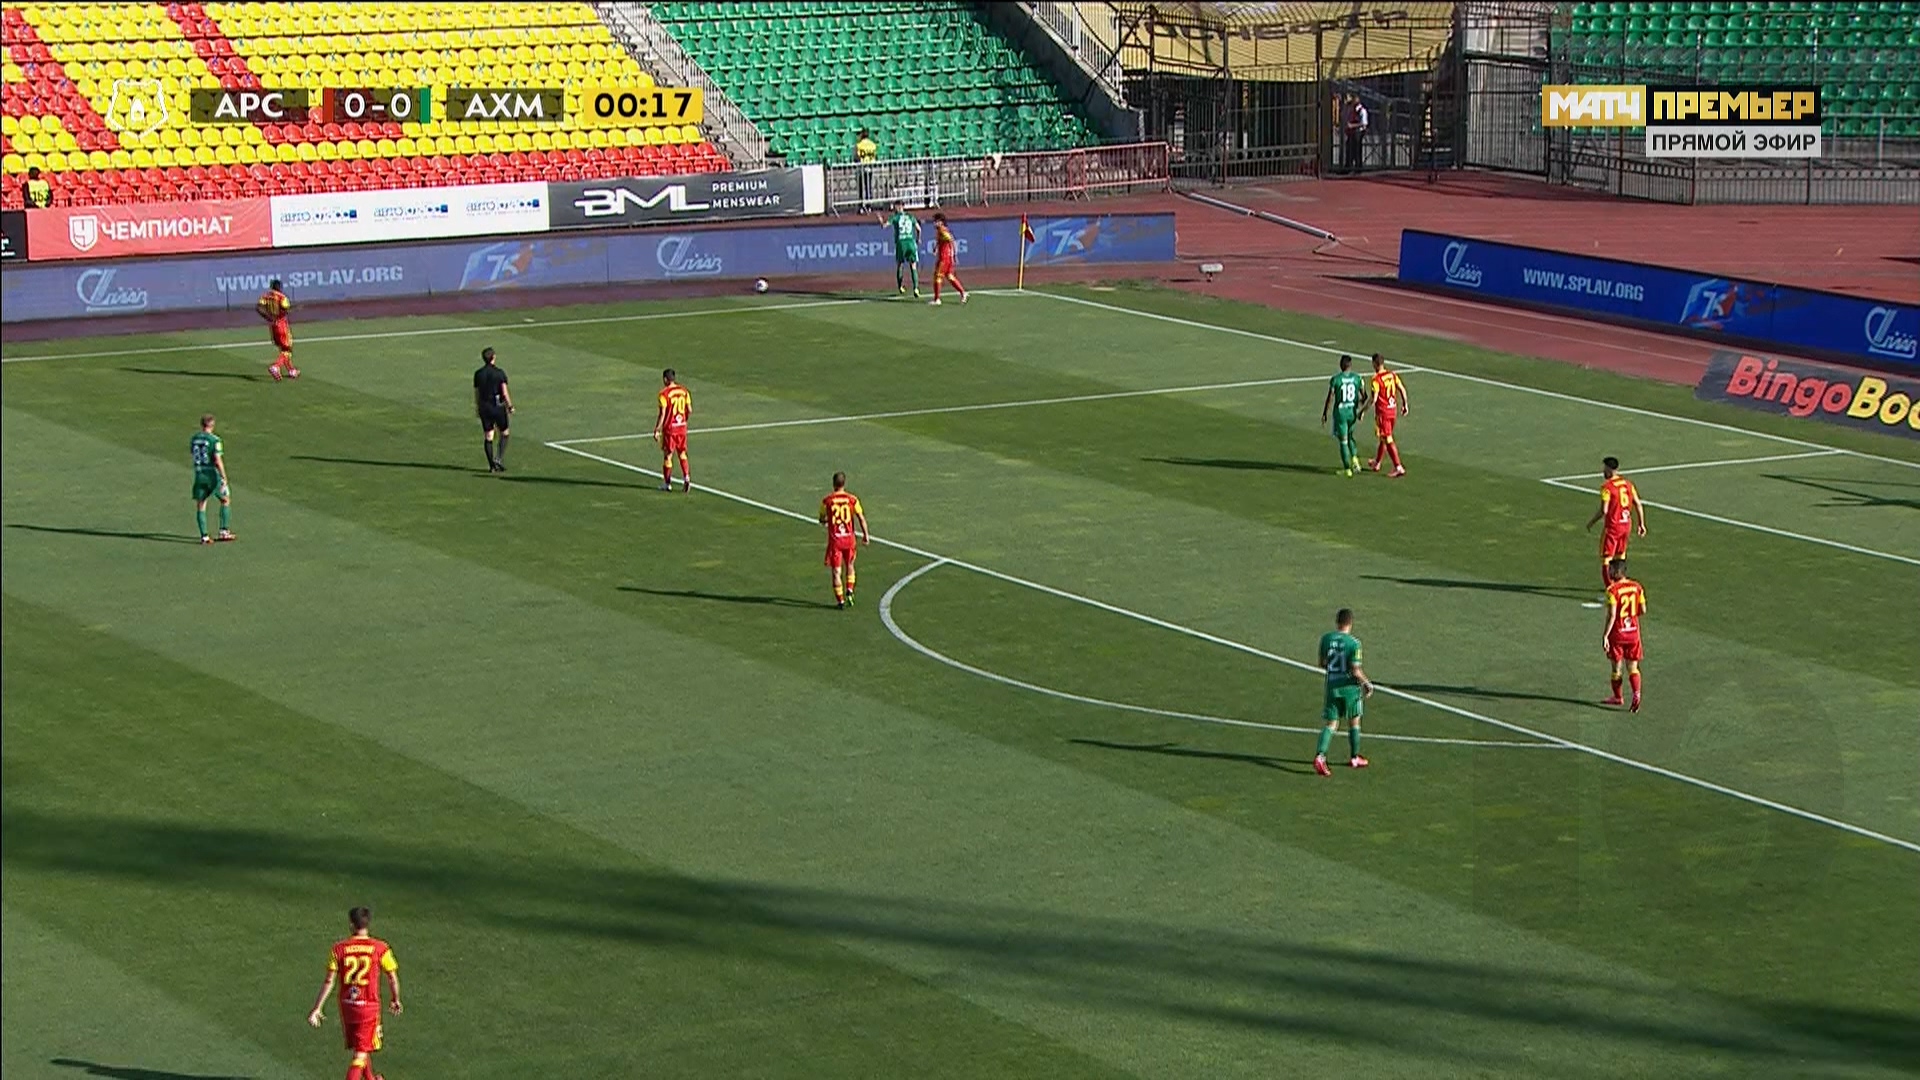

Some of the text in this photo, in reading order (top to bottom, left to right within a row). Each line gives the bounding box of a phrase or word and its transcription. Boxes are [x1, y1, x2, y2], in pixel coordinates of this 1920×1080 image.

[712, 181, 768, 193] PREMIUM
[575, 184, 710, 216] BML
[712, 195, 780, 208] MENSWEAR
[101, 216, 233, 241] ЧЕМПИОНАТ
[786, 239, 968, 260] WWW.SPL.OG
[1523, 267, 1644, 301] WWW.SPLAV.ORG
[1341, 383, 1355, 402] 18
[1619, 487, 1629, 508] 6
[831, 504, 852, 525] 20
[1620, 594, 1638, 619] 21
[343, 955, 372, 986] 22
